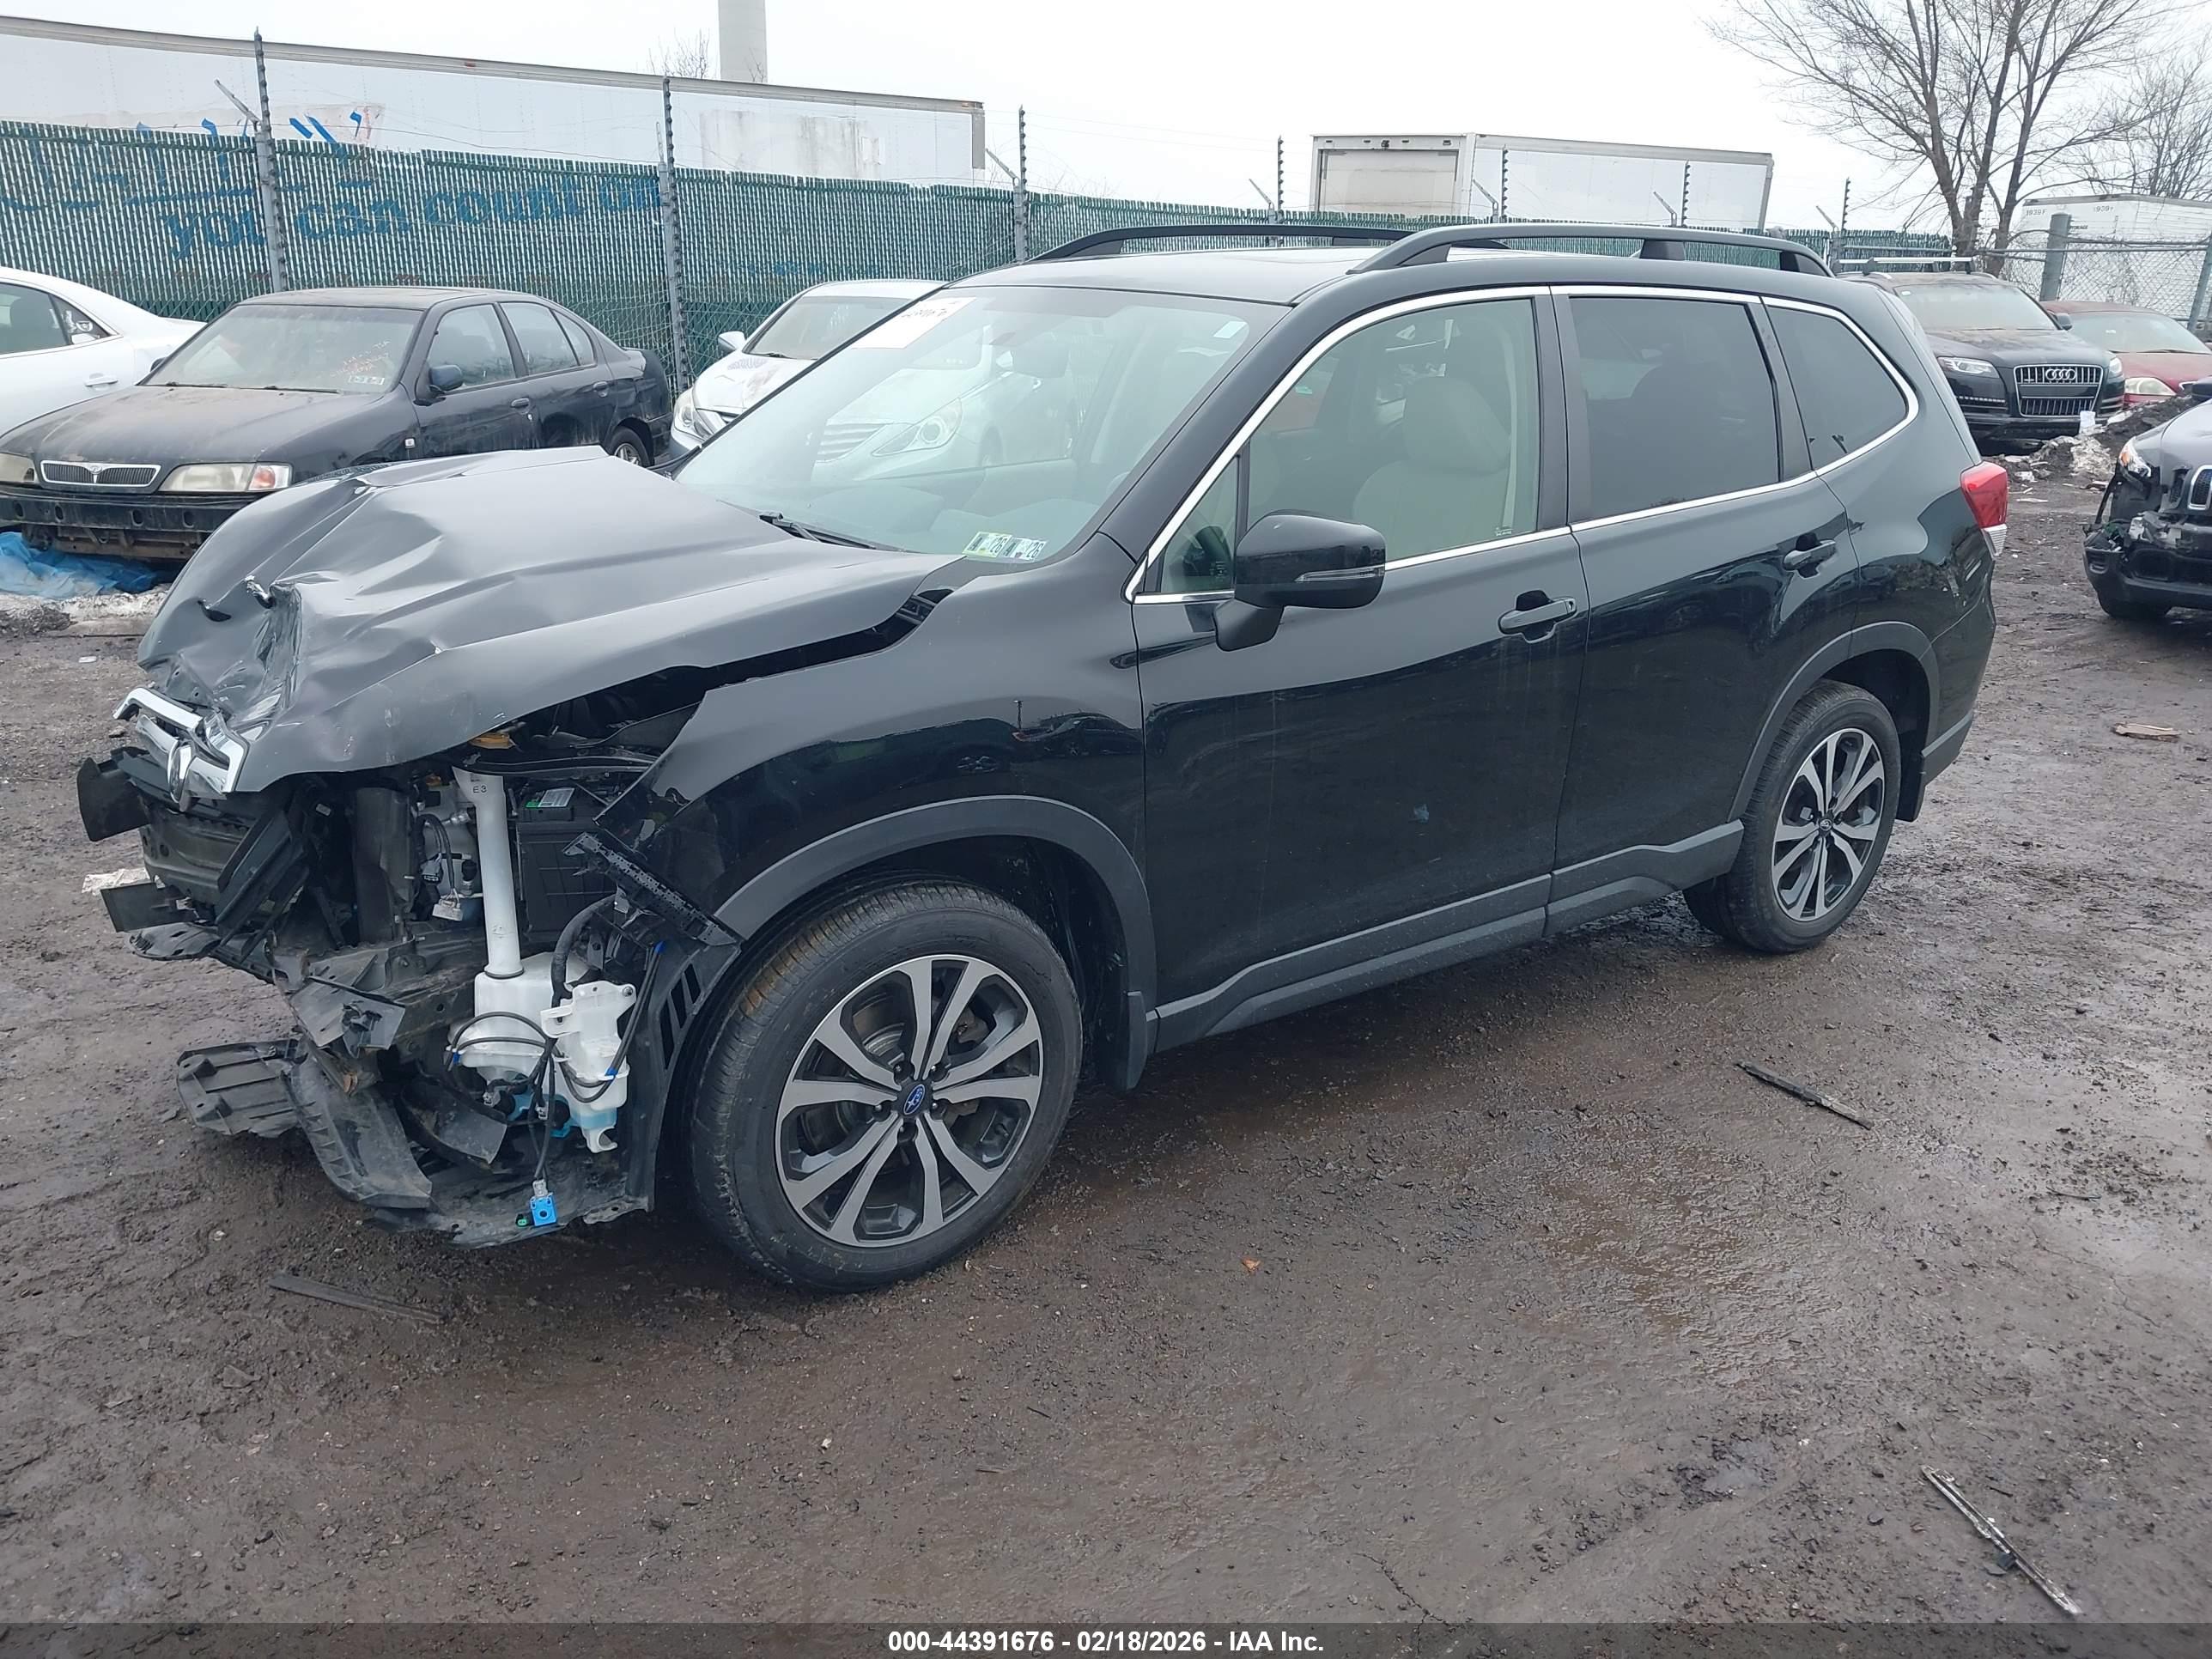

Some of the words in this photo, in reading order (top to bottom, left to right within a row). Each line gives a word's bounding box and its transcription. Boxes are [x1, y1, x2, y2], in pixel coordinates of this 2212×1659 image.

[295, 198, 411, 240] can
[426, 175, 586, 225] count
[472, 785, 487, 793] E3
